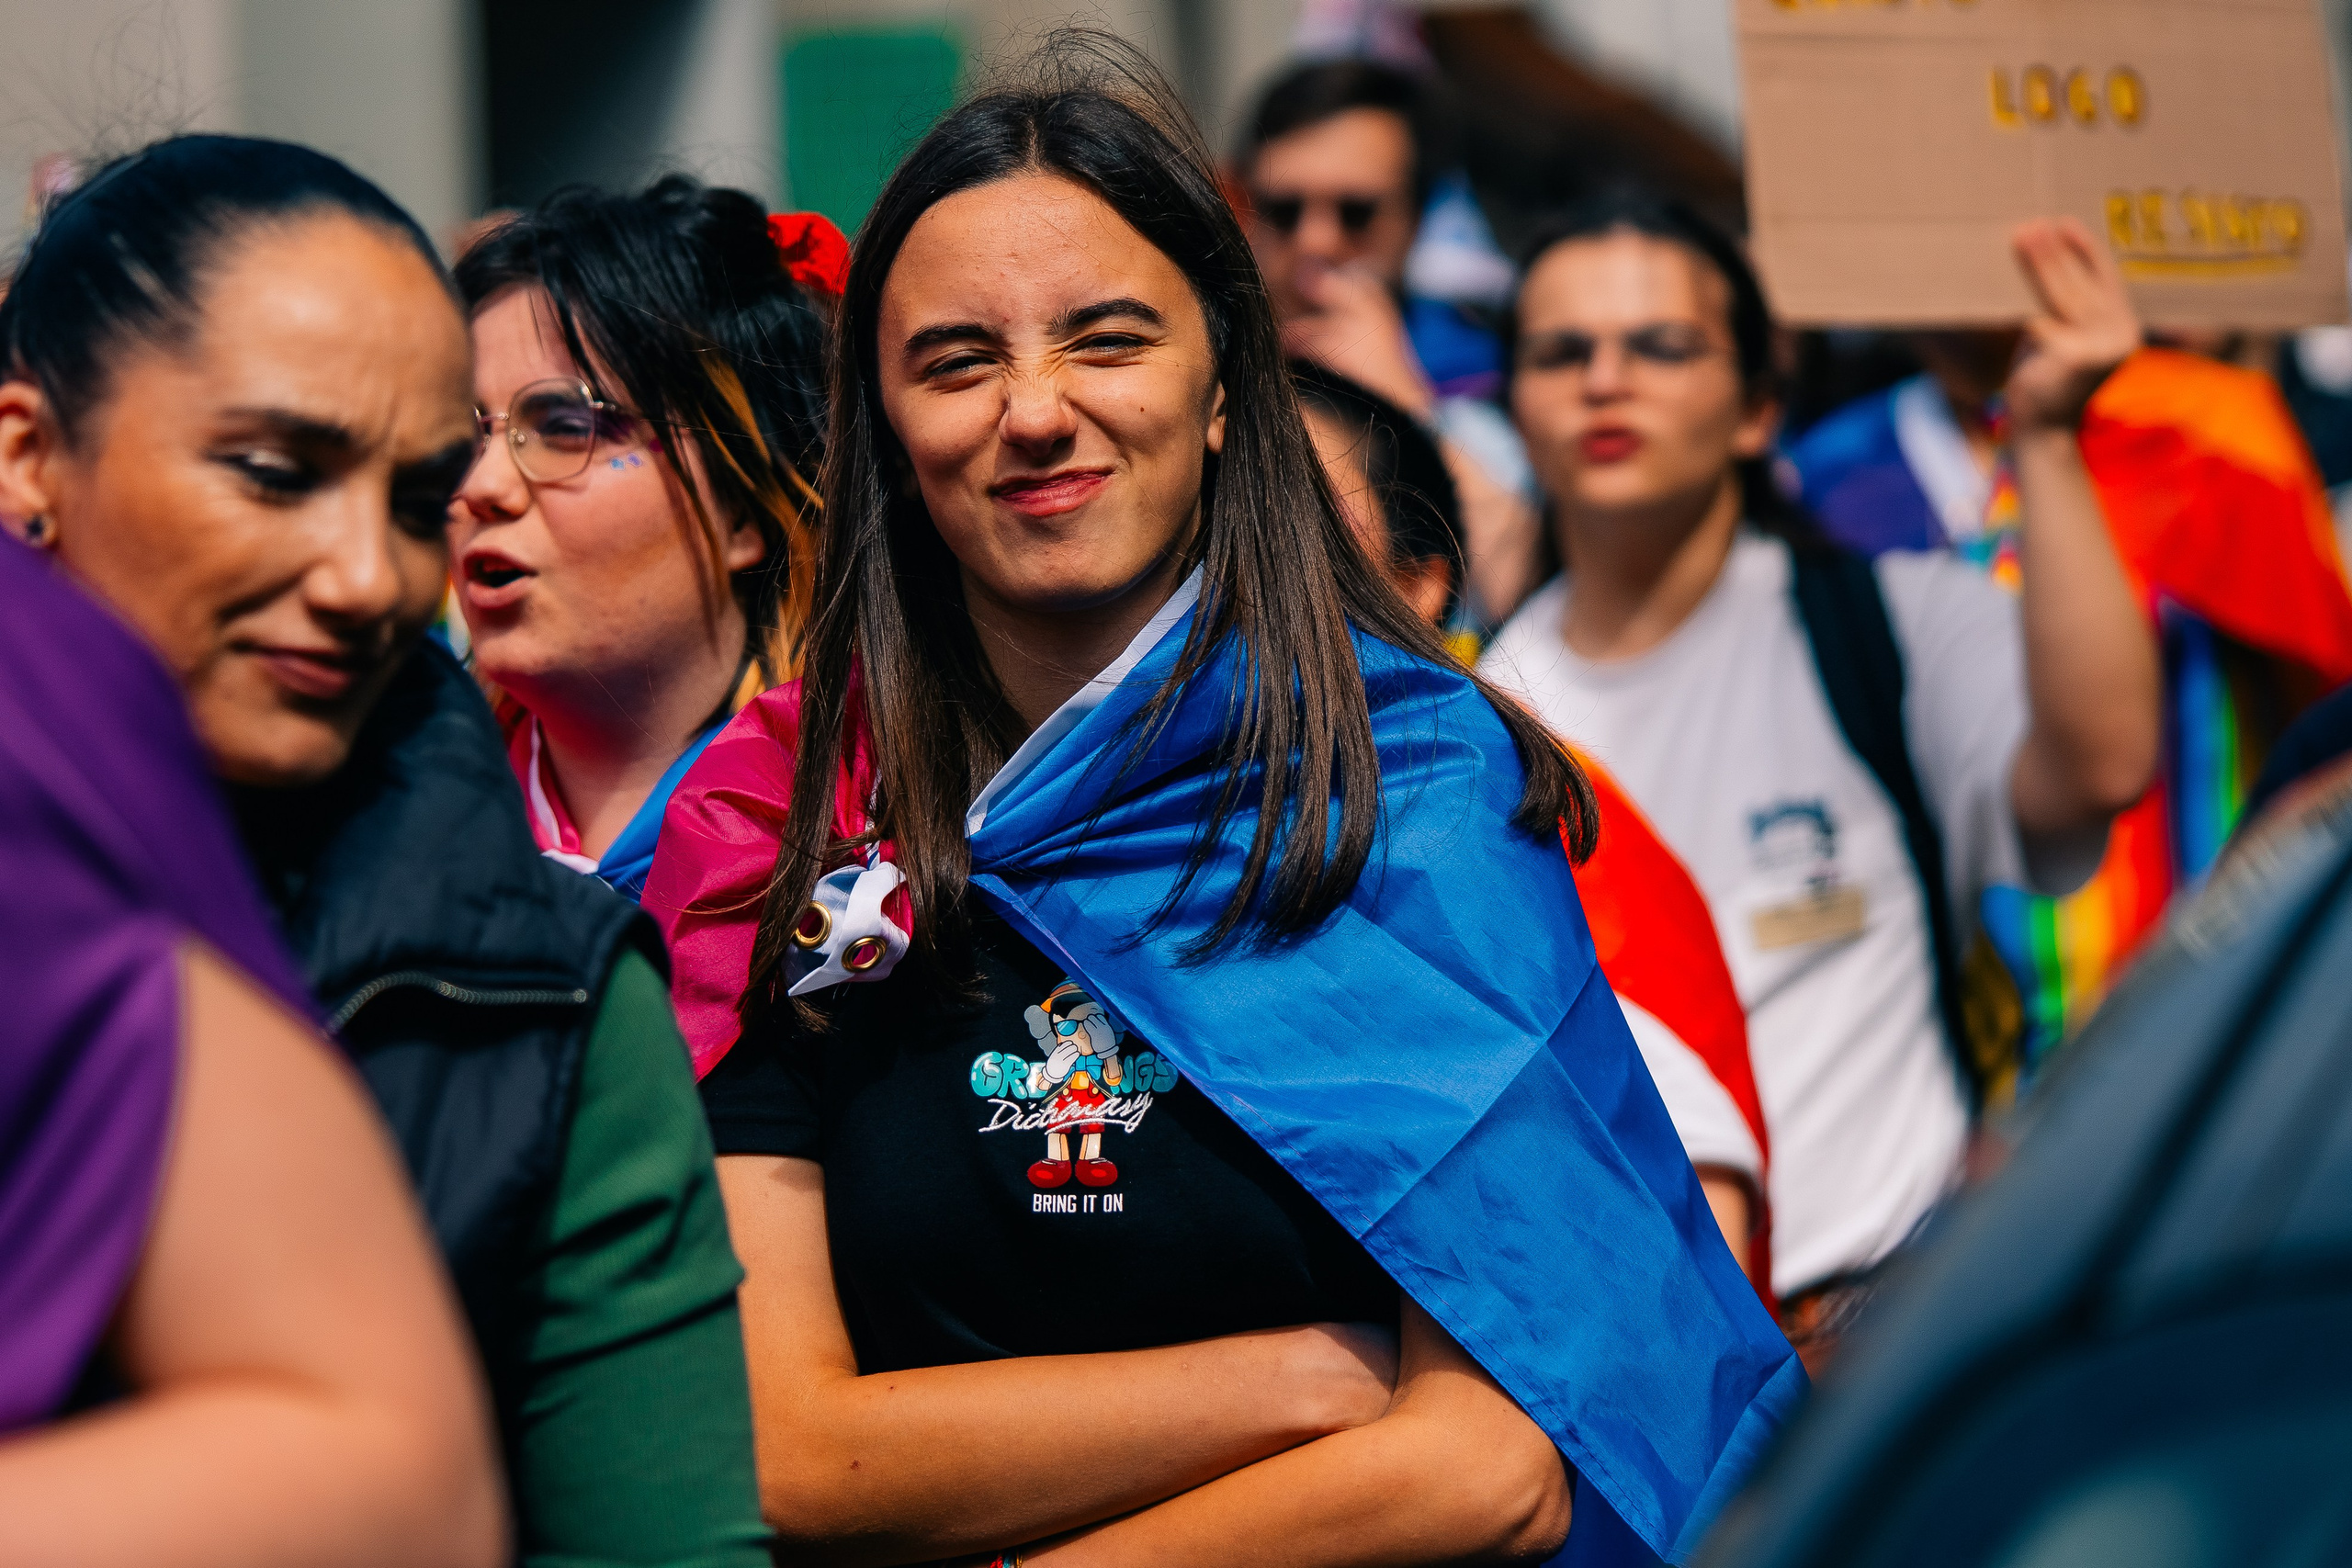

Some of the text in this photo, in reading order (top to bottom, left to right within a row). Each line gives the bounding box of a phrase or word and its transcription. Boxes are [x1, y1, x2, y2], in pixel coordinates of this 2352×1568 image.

[1989, 64, 2146, 129] LOGO
[1033, 1193, 1124, 1213] BRING IT ON
